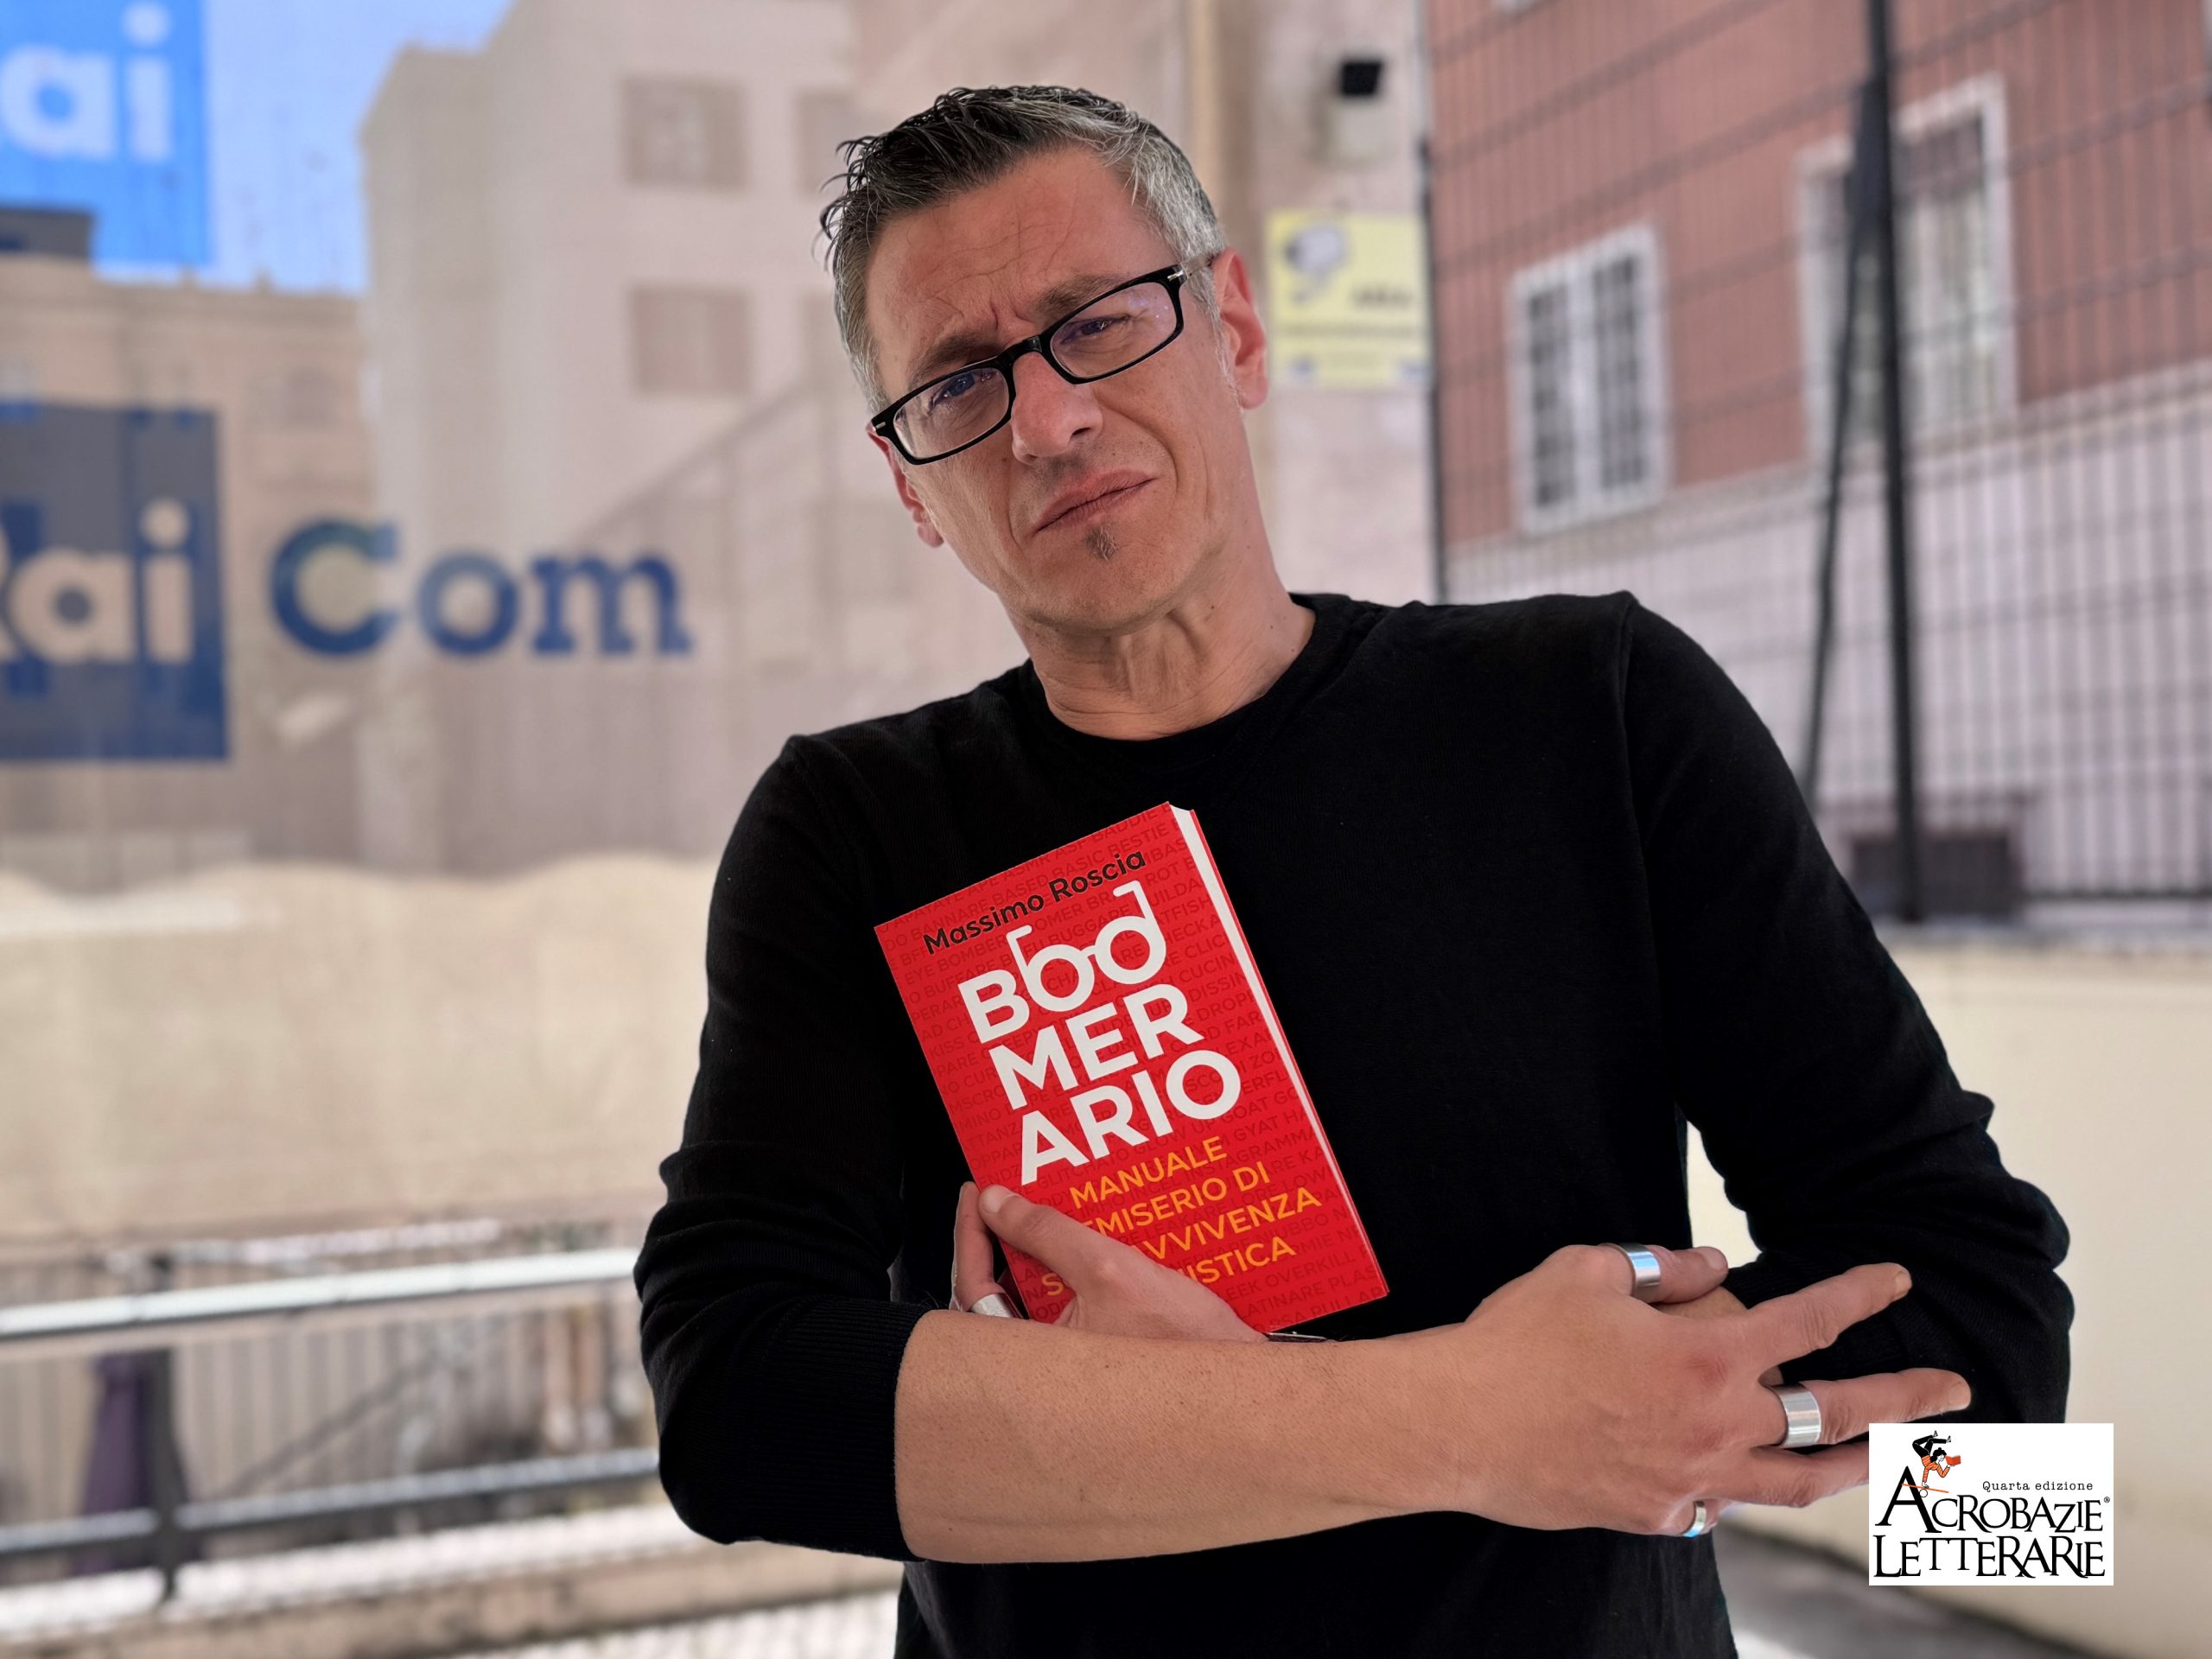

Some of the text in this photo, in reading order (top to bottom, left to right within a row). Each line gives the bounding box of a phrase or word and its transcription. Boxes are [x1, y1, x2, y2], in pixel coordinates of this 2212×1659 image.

[270, 517, 693, 657] Com
[924, 895, 1044, 954] Massimo
[1049, 852, 1145, 901] Roscia
[991, 873, 1049, 906] BASED
[1052, 849, 1105, 880] BASIC
[1107, 822, 1169, 857] BESTIE
[989, 984, 1204, 1109] MER
[1022, 1051, 1240, 1185] ARIO
[1232, 1115, 1281, 1141] GYAT
[1071, 1136, 1226, 1208] MANUALE
[1082, 1179, 1226, 1236] MISERIO
[1233, 1162, 1269, 1191] DI
[1179, 1237, 1295, 1283] ISTICA
[1262, 1247, 1357, 1289] OVERKILL
